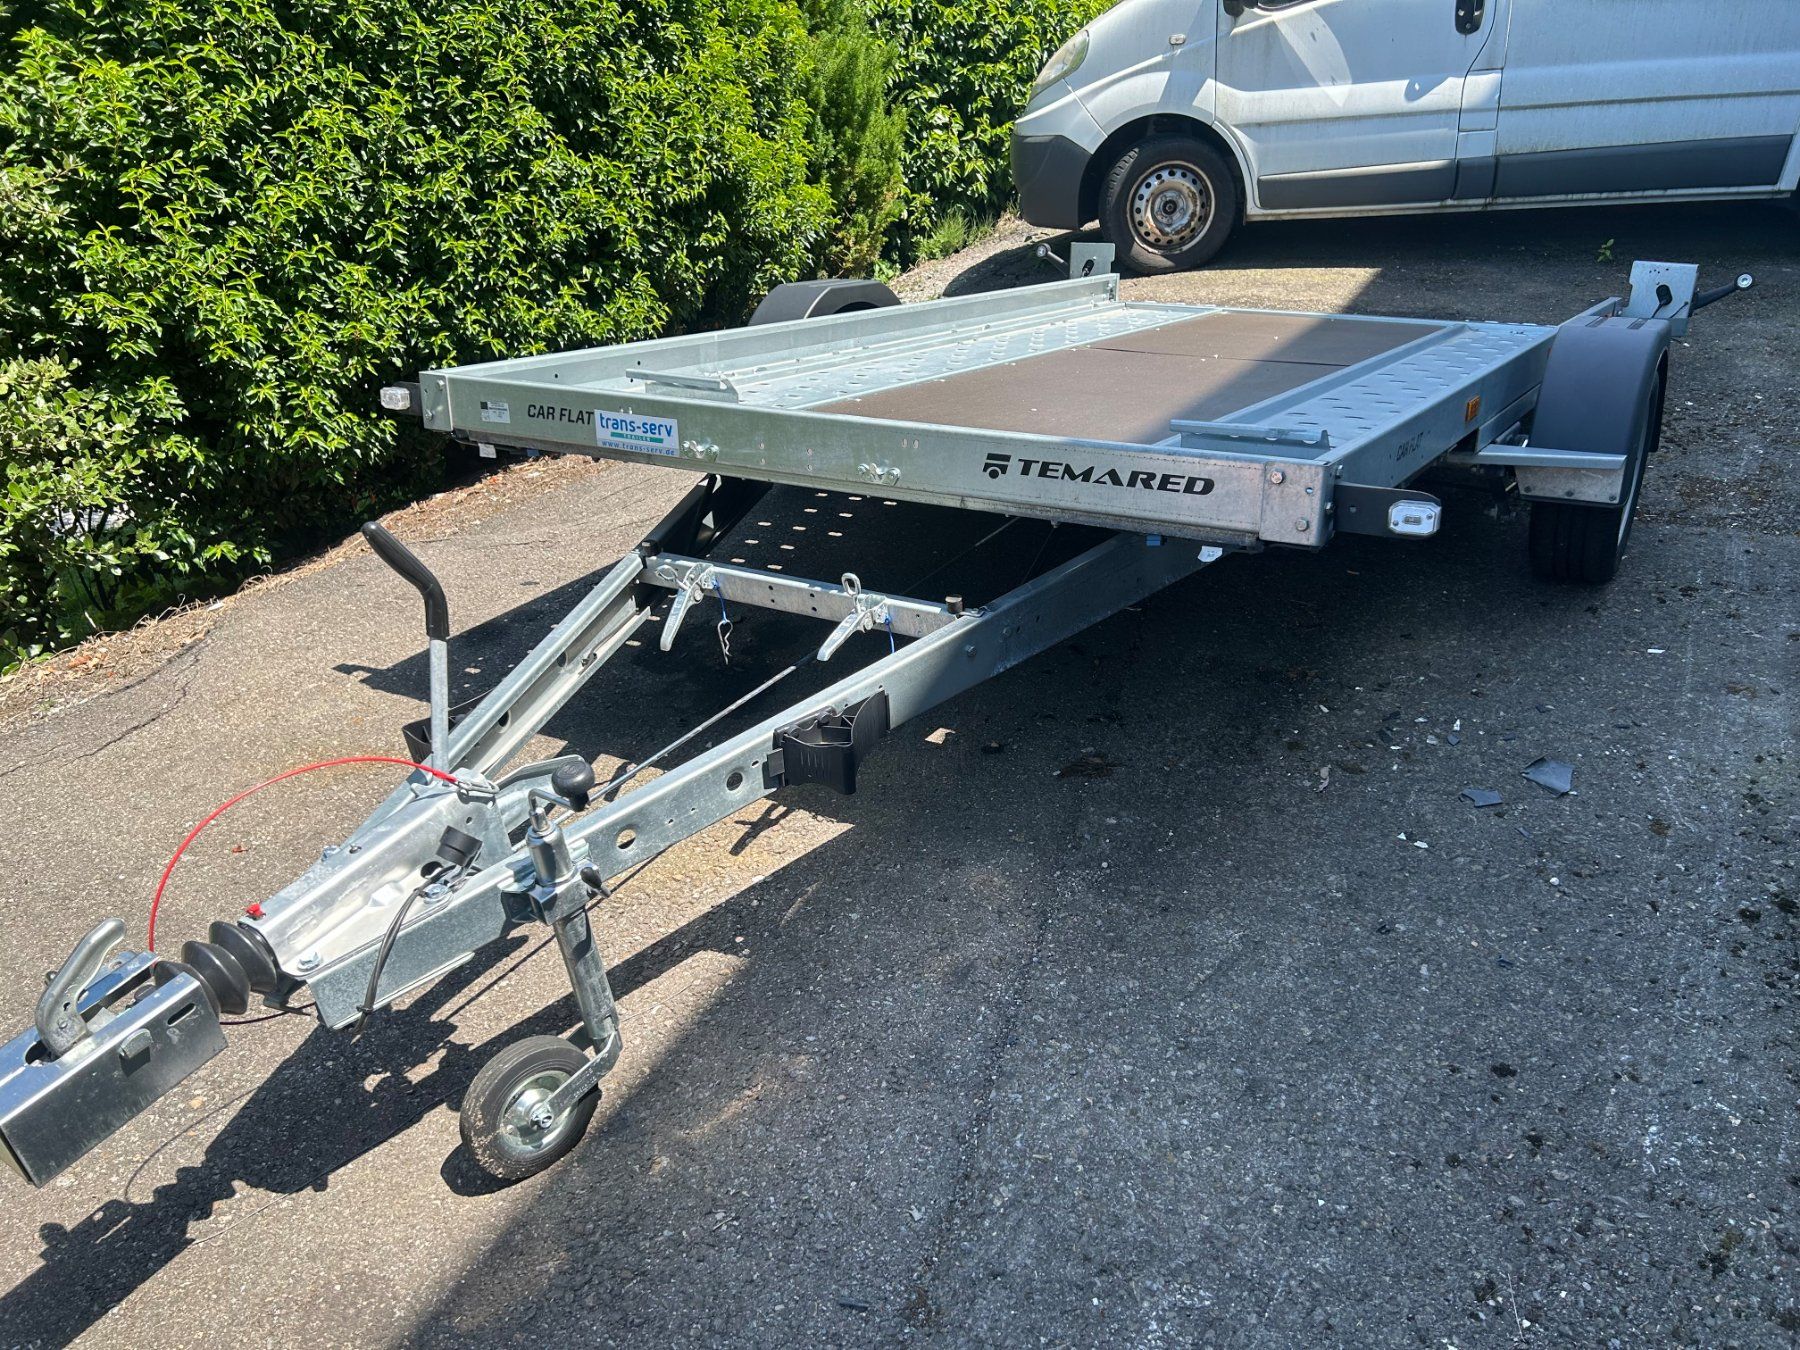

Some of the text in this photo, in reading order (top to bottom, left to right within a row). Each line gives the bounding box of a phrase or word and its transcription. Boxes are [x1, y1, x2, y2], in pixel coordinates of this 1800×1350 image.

[527, 404, 555, 421] CAR
[559, 408, 594, 425] FLAT
[599, 412, 673, 437] trans-serv
[601, 440, 675, 455] www.trans-serv.de
[1017, 457, 1216, 496] TEMARED
